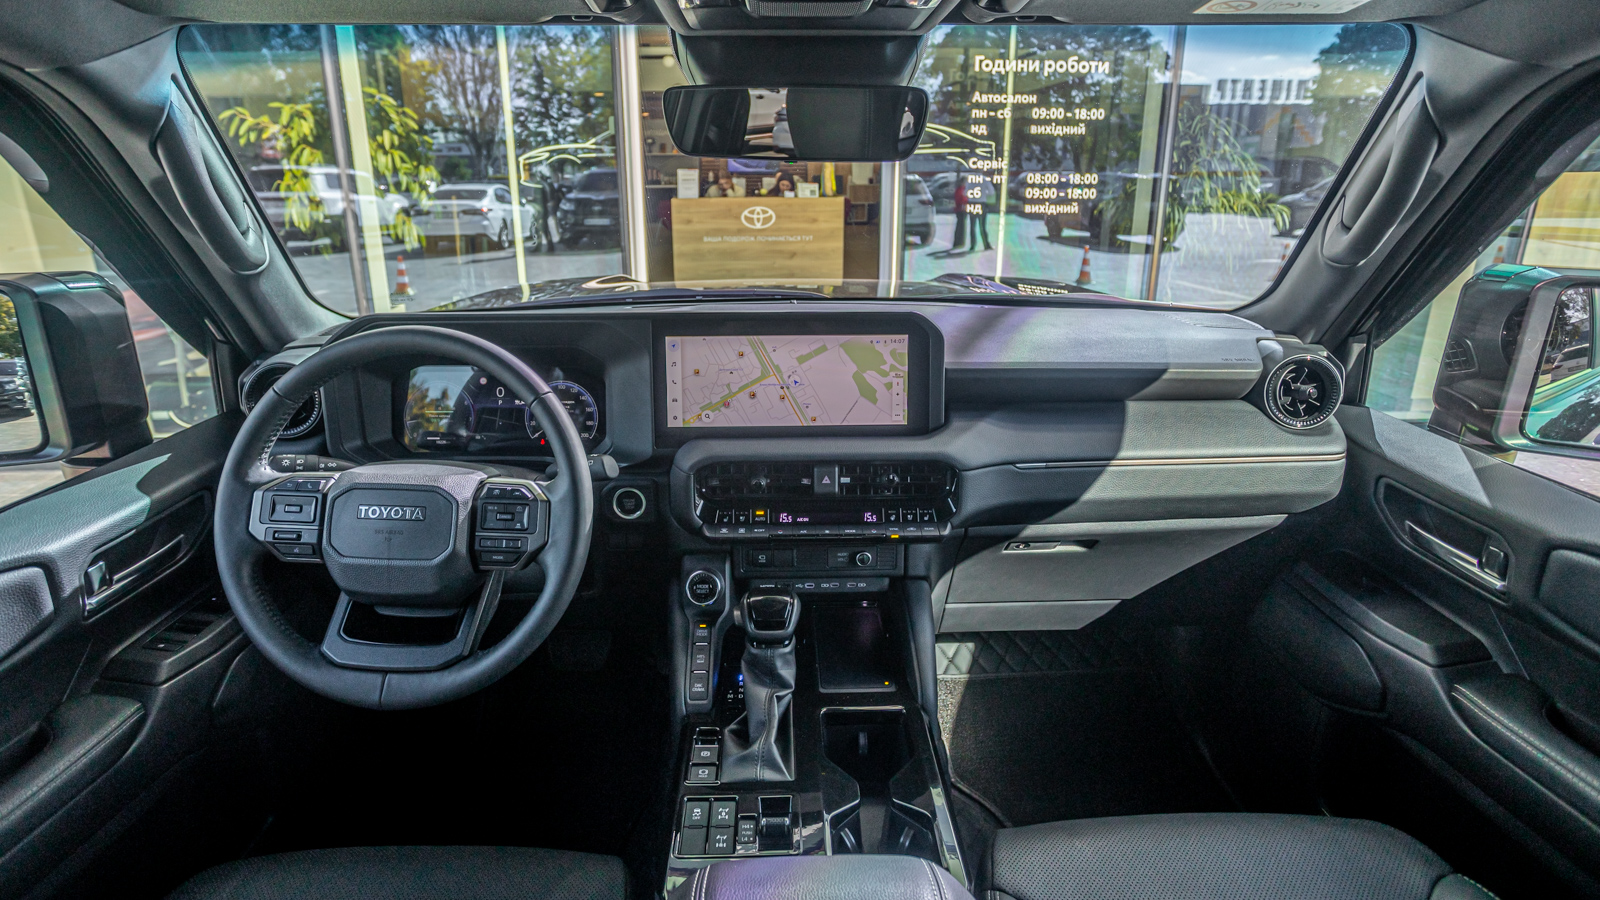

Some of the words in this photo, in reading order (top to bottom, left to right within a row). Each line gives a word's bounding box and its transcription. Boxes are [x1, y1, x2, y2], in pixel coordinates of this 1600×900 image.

[974, 55, 1041, 75] Години
[1044, 55, 1110, 77] роботи
[972, 91, 1037, 104] Автосалон
[971, 109, 987, 119] пн
[996, 107, 1012, 119] сб
[1031, 108, 1065, 119] 09:00
[1073, 108, 1105, 120] 18:00
[970, 124, 988, 135] нд
[1030, 123, 1086, 136] вихідний
[968, 157, 1008, 171] Сервіс
[967, 174, 983, 184] пн
[993, 174, 1007, 184] пт
[1026, 173, 1059, 184] 08:00
[1068, 173, 1099, 185] 18:00
[966, 187, 981, 198] сб
[1025, 188, 1058, 199] 09:00
[1066, 188, 1096, 199] 18:00
[966, 203, 982, 214] нд
[1024, 202, 1079, 215] вихідний
[496, 386, 505, 397] 0
[358, 505, 424, 520] TOYOTA
